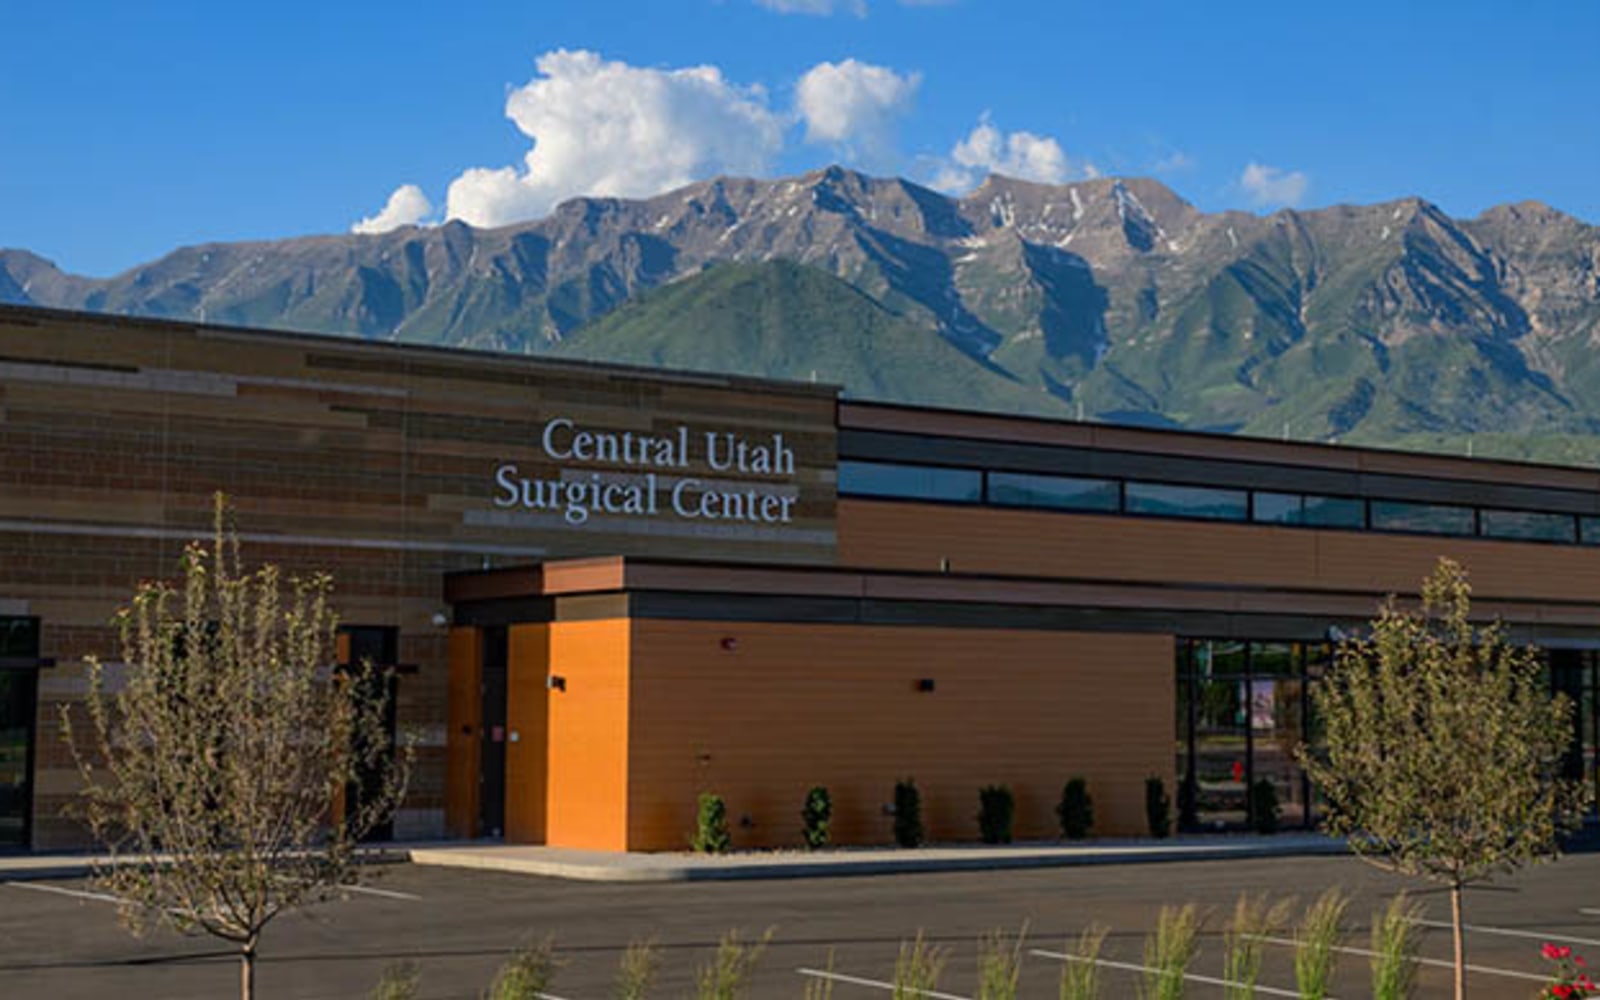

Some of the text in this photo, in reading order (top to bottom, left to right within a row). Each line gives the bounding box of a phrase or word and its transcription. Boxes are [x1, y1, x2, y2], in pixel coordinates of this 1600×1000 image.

[542, 418, 796, 475] Central Utah
[494, 465, 797, 524] Surgical Center
